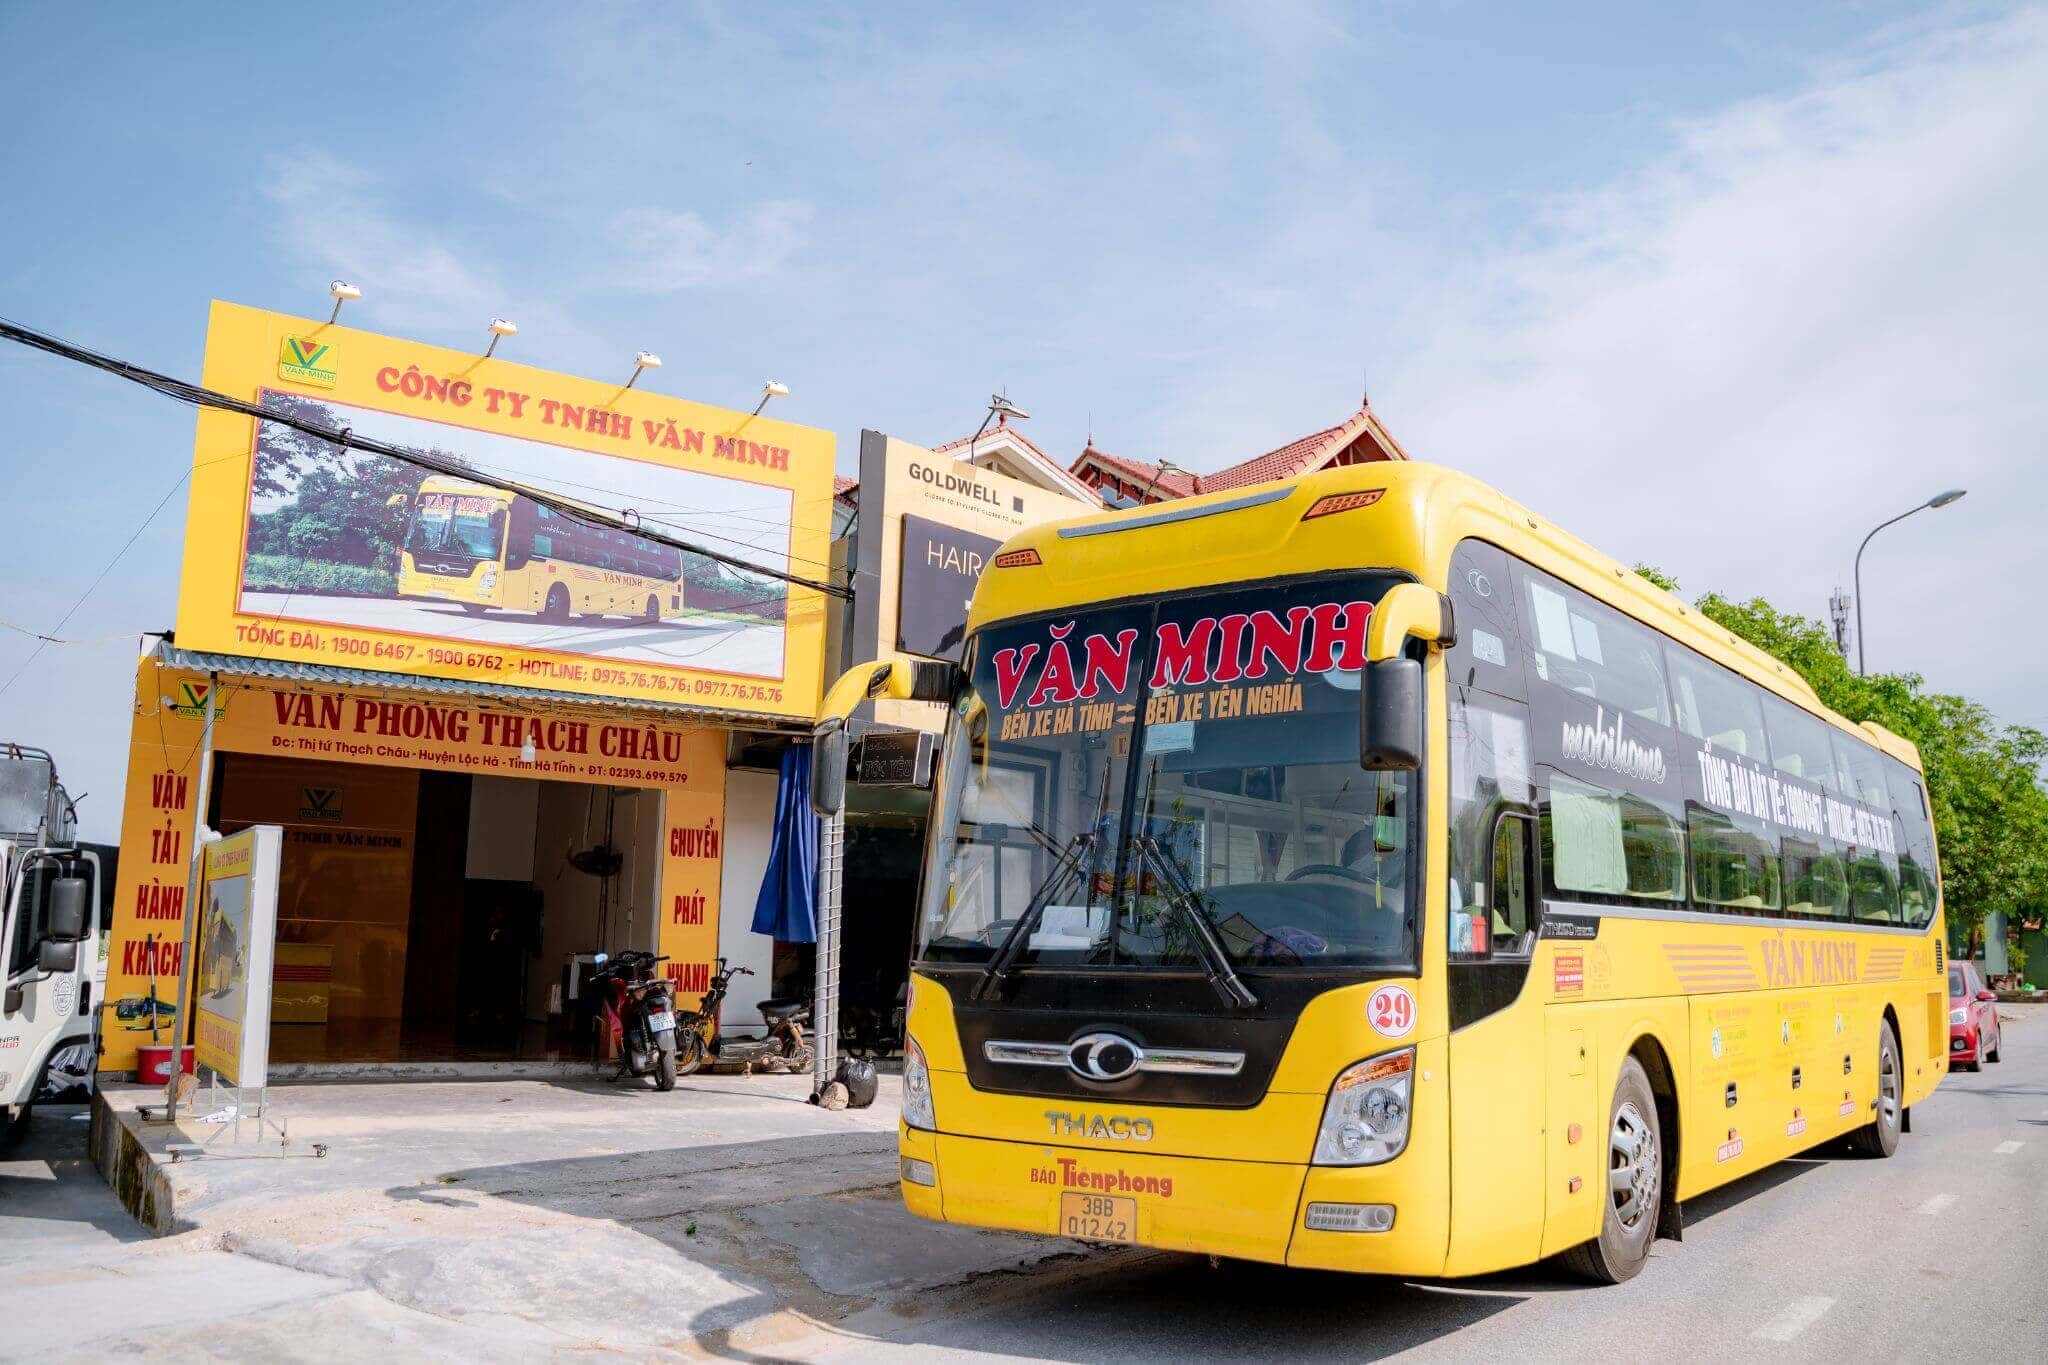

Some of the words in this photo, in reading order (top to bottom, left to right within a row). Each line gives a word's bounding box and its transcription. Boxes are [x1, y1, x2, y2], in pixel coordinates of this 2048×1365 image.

[376, 365, 473, 407] CÔNG
[483, 387, 530, 417] TY
[539, 398, 633, 441] TNHH
[642, 417, 706, 455] VĂN
[712, 433, 791, 471] MINH
[909, 463, 1000, 507] GOLDWELL
[928, 540, 982, 577] HAIR
[236, 619, 285, 647] TỔNG
[332, 636, 370, 656] 1900
[373, 641, 415, 662] 6467
[427, 647, 463, 665] 1900
[467, 653, 503, 670] 6762
[992, 620, 1138, 709] VĂN
[1148, 600, 1375, 688] MINH
[1001, 703, 1031, 740] BẾN
[1032, 710, 1053, 736] XE
[1053, 702, 1075, 734] HÀ
[1077, 698, 1114, 732] TĨNH
[1145, 687, 1181, 726] BẾN
[1180, 692, 1205, 723] XE
[1208, 684, 1242, 719] YÊN
[1246, 678, 1303, 715] NGHĨA
[298, 738, 316, 753] Thị
[335, 741, 373, 756] Thạch
[418, 750, 456, 765] Huyện
[459, 753, 480, 767] Lộc
[553, 760, 576, 774] Tĩnh
[588, 765, 607, 777] ĐT:
[609, 767, 688, 783] 02393.699.579
[600, 724, 682, 763] CHÂU
[152, 769, 188, 815] VẬN
[152, 818, 181, 865] TẢI
[670, 818, 719, 859] CHUYỂN
[136, 877, 184, 921] HÀNH
[673, 888, 706, 925] PHÁT
[122, 932, 183, 976] KHÁCH
[1761, 927, 1806, 986] VĂN
[1811, 940, 1857, 984] MINH
[667, 963, 709, 993] NHANH
[1376, 993, 1410, 1028] 29
[1045, 1111, 1154, 1142] THACO
[1030, 1165, 1056, 1185] BÁO
[1068, 1216, 1127, 1241] 012.42
[1082, 1196, 1114, 1217] 38B
